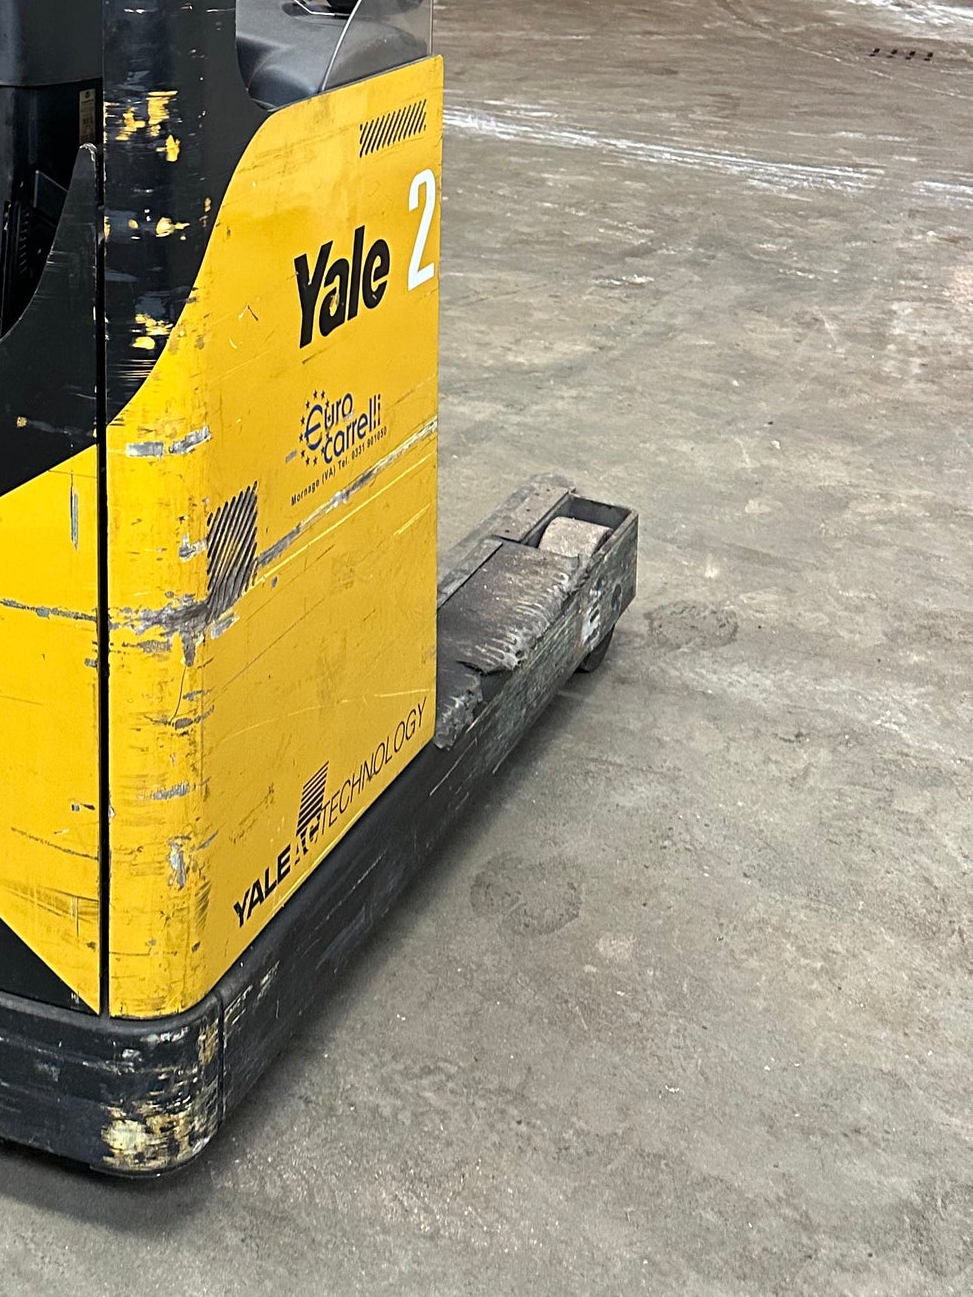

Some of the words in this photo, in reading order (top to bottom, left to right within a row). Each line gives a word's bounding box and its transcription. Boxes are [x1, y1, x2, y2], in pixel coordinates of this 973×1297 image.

[293, 224, 391, 349] Yale
[407, 168, 436, 292] 2
[291, 479, 320, 506] Mornago
[322, 466, 336, 485] (VA)
[338, 457, 350, 470] Tel.
[351, 443, 365, 460] 0331
[233, 843, 292, 928] YALE
[320, 696, 427, 835] TECHNOLOGY
